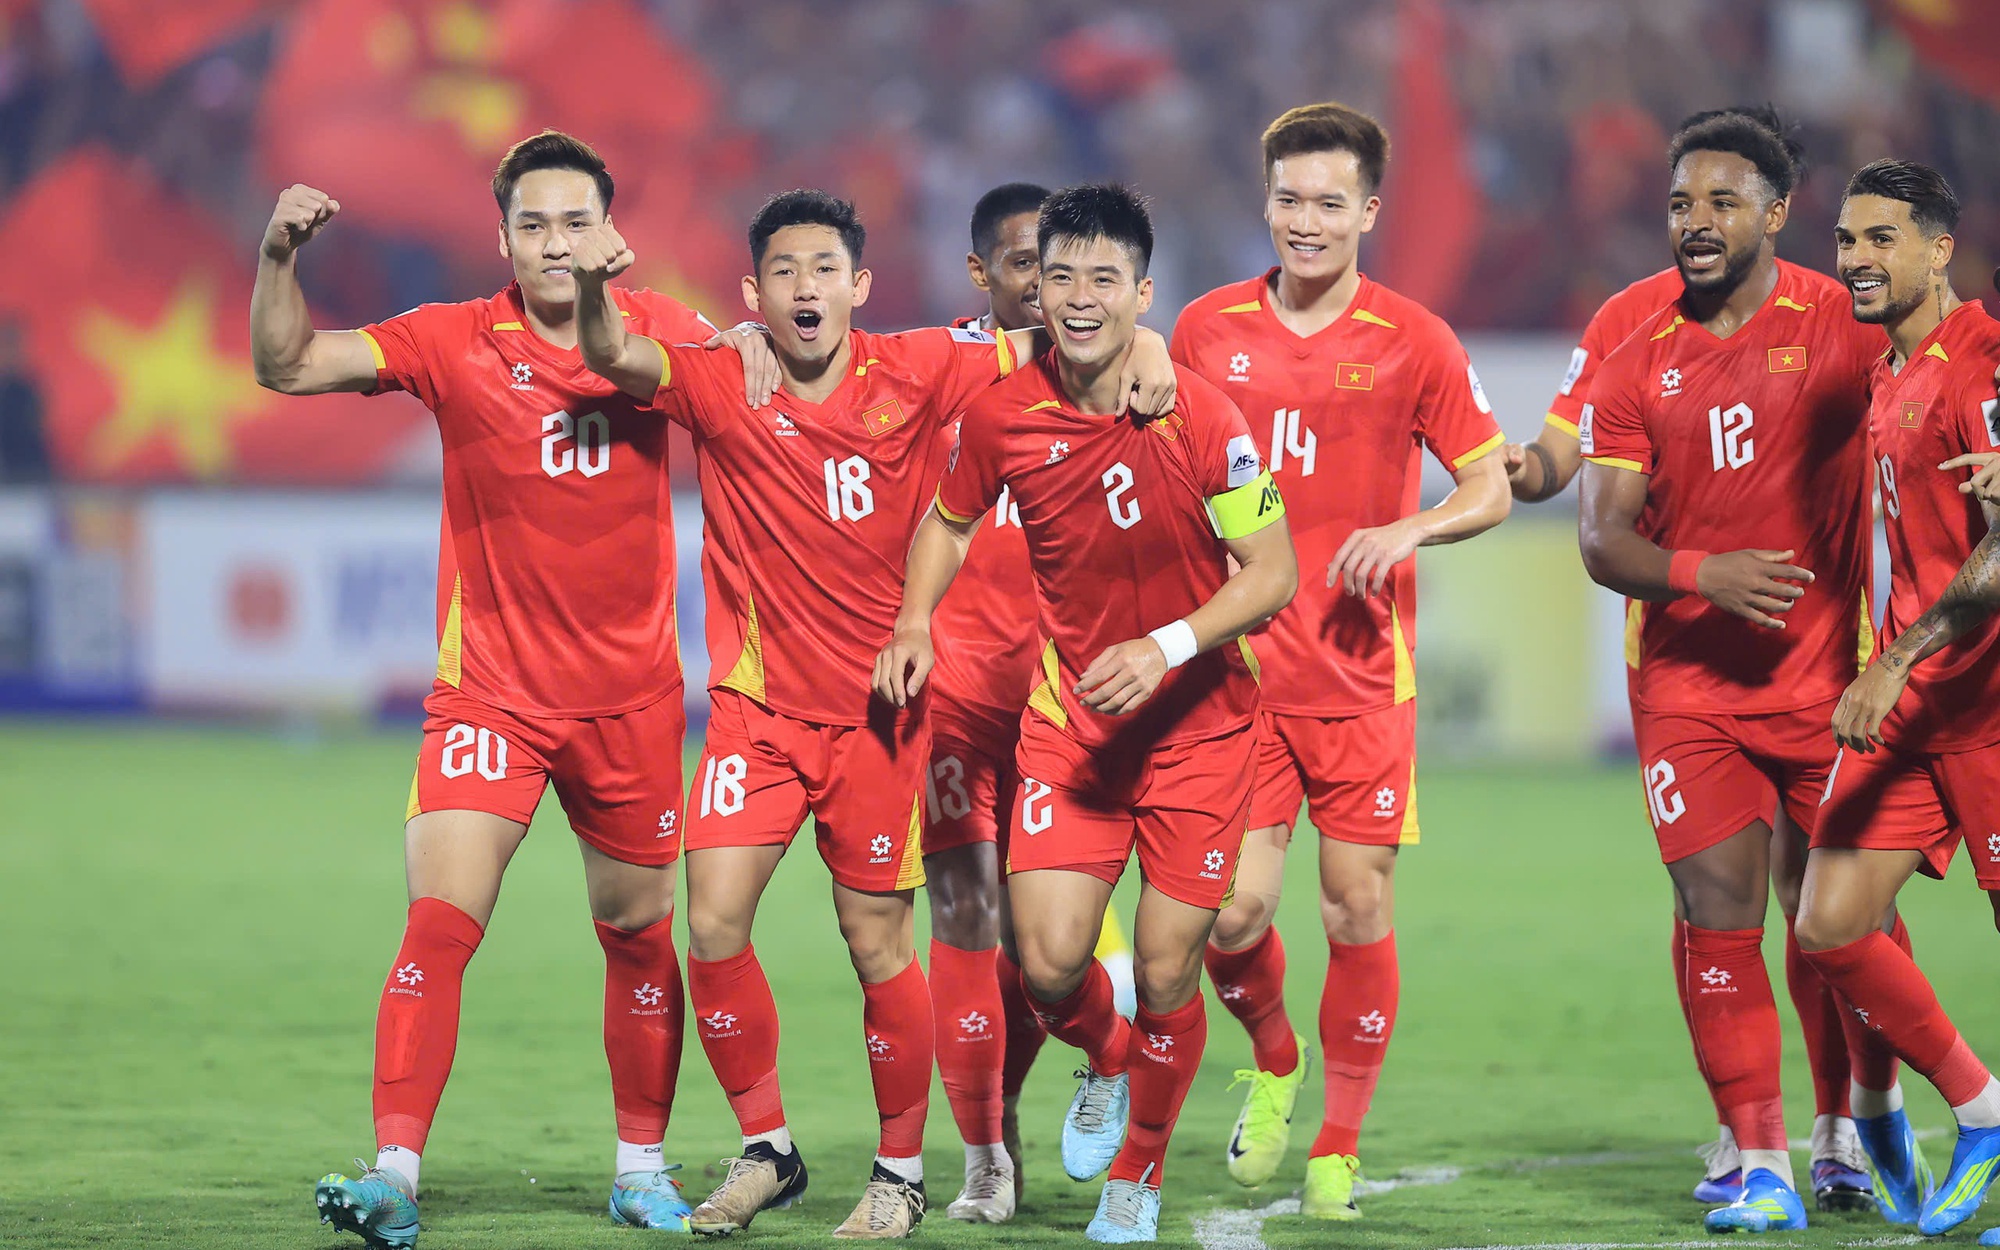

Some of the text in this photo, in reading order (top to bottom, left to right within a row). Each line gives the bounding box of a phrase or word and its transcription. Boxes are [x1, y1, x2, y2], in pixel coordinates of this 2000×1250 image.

[541, 410, 611, 479] 20
[1270, 407, 1318, 477] 14
[1709, 402, 1755, 472] 12
[824, 454, 875, 523] 18
[1102, 462, 1142, 530] 2
[1880, 454, 1901, 519] 9
[440, 724, 509, 782] 20
[700, 754, 748, 819] 18
[926, 755, 971, 825] 13
[1022, 777, 1053, 836] 2
[1644, 758, 1687, 829] 12
